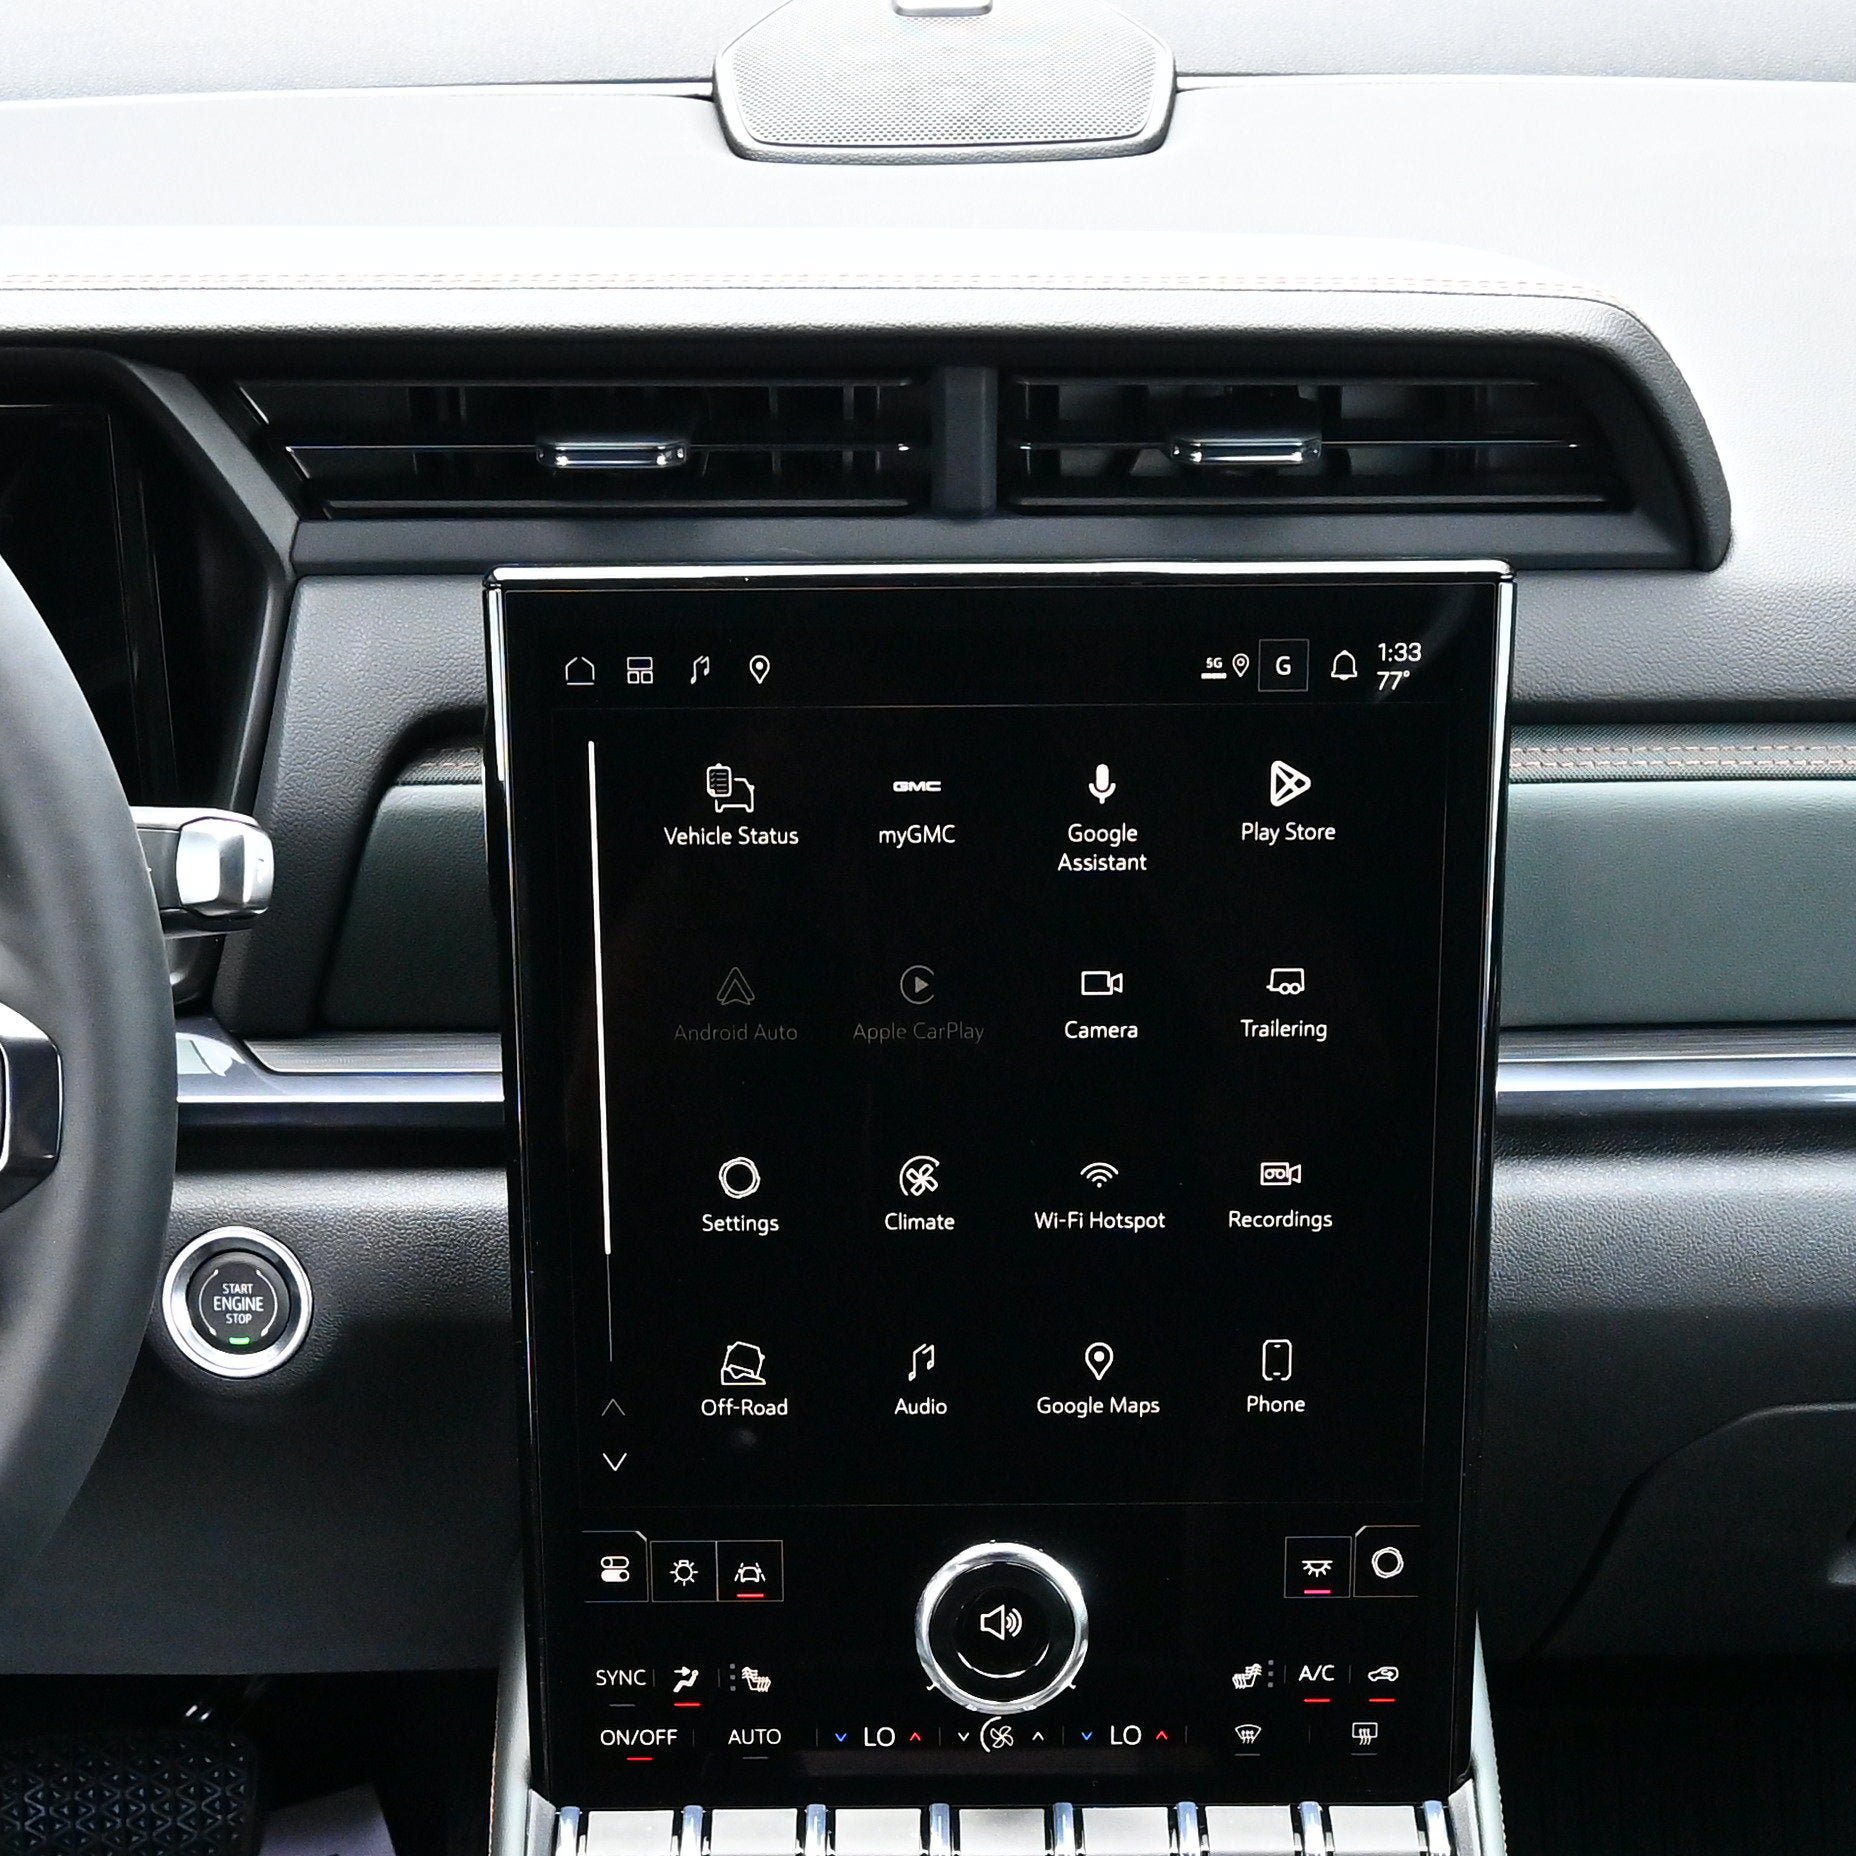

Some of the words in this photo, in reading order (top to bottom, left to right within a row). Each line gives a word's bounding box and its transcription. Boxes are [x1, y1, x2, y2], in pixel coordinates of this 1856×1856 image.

[1205, 656, 1223, 669] 5G
[1377, 642, 1422, 663] 1:33
[1376, 669, 1411, 691] 77°
[892, 780, 942, 793] GMC
[663, 825, 733, 846] Vehicle
[738, 825, 800, 845] Status
[878, 824, 956, 849] myGMC
[1066, 822, 1138, 849] Google
[1241, 821, 1280, 846] Play
[1284, 821, 1336, 841] Store
[1057, 852, 1148, 872] Assistant
[675, 1023, 748, 1041] Android
[753, 1023, 798, 1041] Auto
[853, 1022, 907, 1045] Apple
[913, 1021, 984, 1044] CarPlay
[1064, 1020, 1138, 1039] Camera
[1240, 1018, 1328, 1043] Trailering
[702, 1213, 780, 1237] Settings
[884, 1211, 955, 1231] Climate
[1034, 1211, 1084, 1229] Wi-Fi
[1089, 1211, 1166, 1234] Hotspot
[1228, 1209, 1333, 1233] Recordings
[222, 1283, 254, 1295] START
[213, 1296, 264, 1312] ENGINE
[225, 1313, 253, 1325] STOP
[700, 1397, 788, 1417] Off-Road
[894, 1396, 948, 1415] Audio
[1036, 1395, 1104, 1419] Google
[1110, 1396, 1161, 1418] Maps
[1246, 1394, 1306, 1413] Phone
[595, 1668, 647, 1686] SYNC
[1298, 1664, 1335, 1682] A/C
[600, 1728, 678, 1746] ON/OFF
[727, 1728, 782, 1745] AUTO
[864, 1726, 896, 1747] LO
[1110, 1724, 1142, 1746] LO
